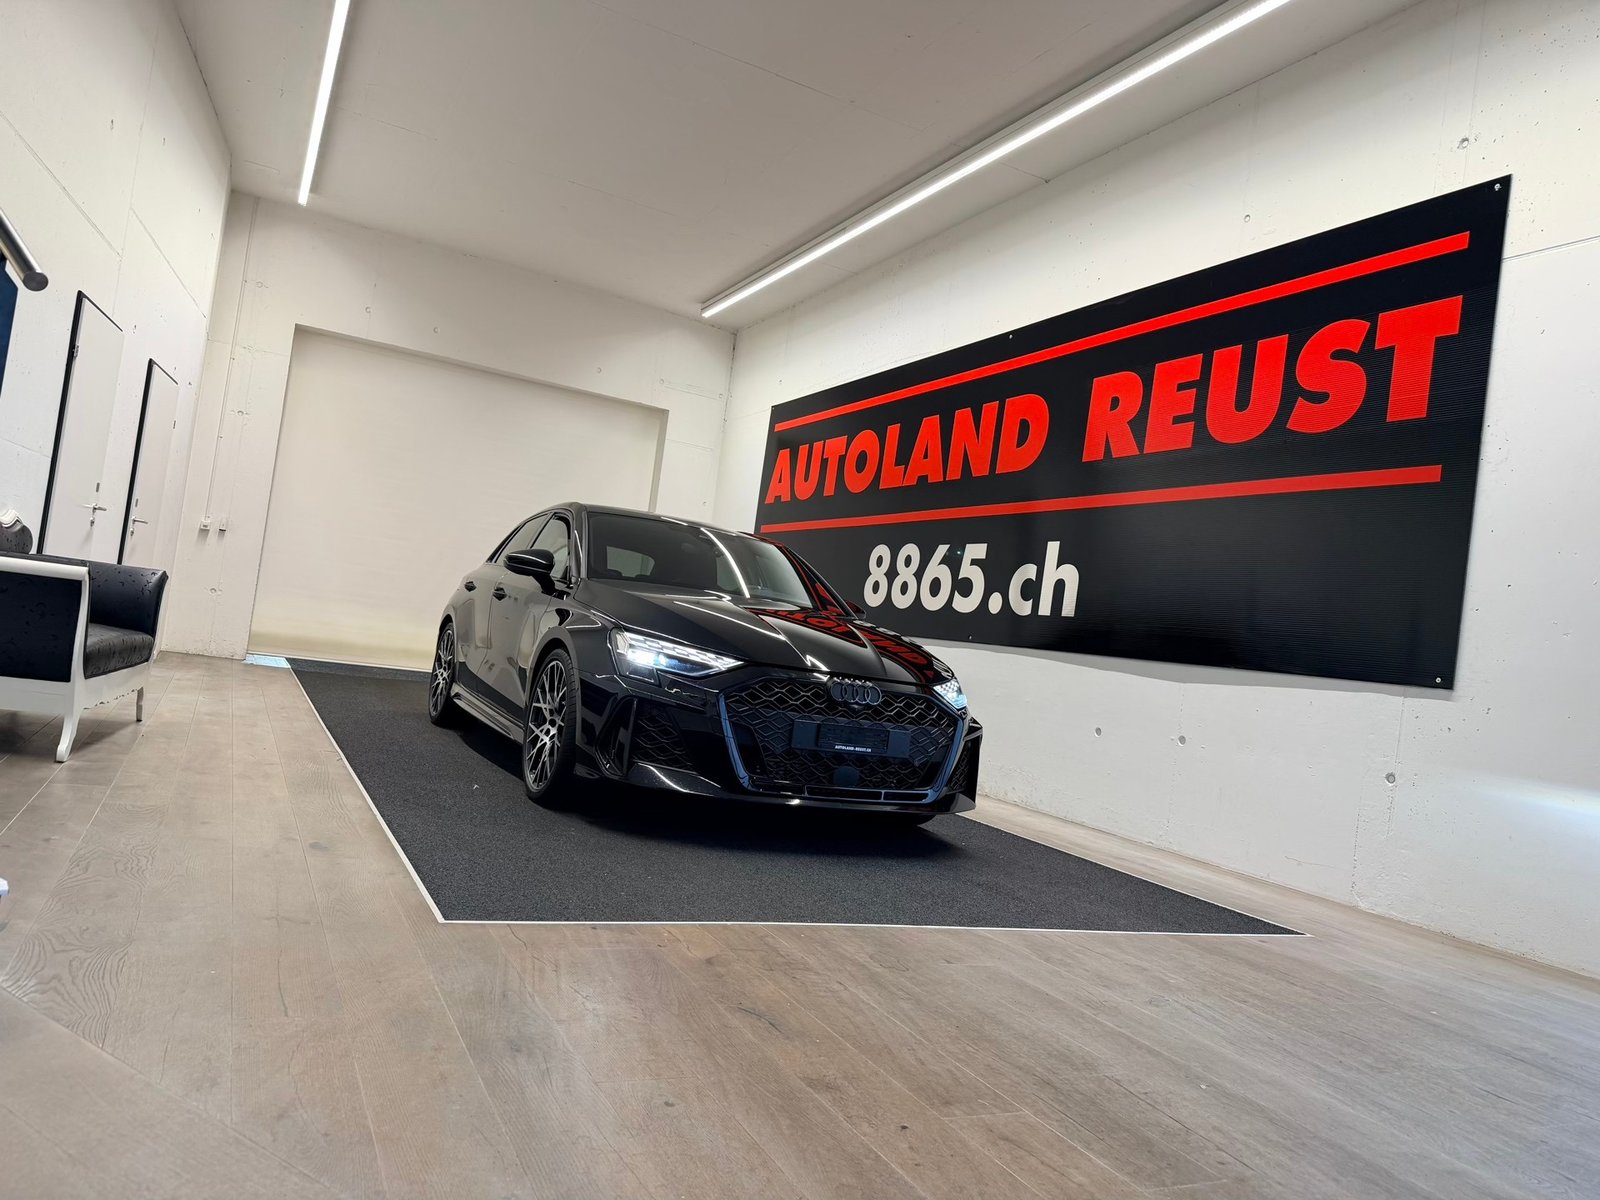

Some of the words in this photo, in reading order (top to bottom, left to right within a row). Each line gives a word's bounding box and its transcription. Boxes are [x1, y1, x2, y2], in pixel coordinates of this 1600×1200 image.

[766, 394, 1050, 505] AUTOLAND
[1082, 295, 1463, 462] REUST
[864, 541, 1079, 617] 8865.ch
